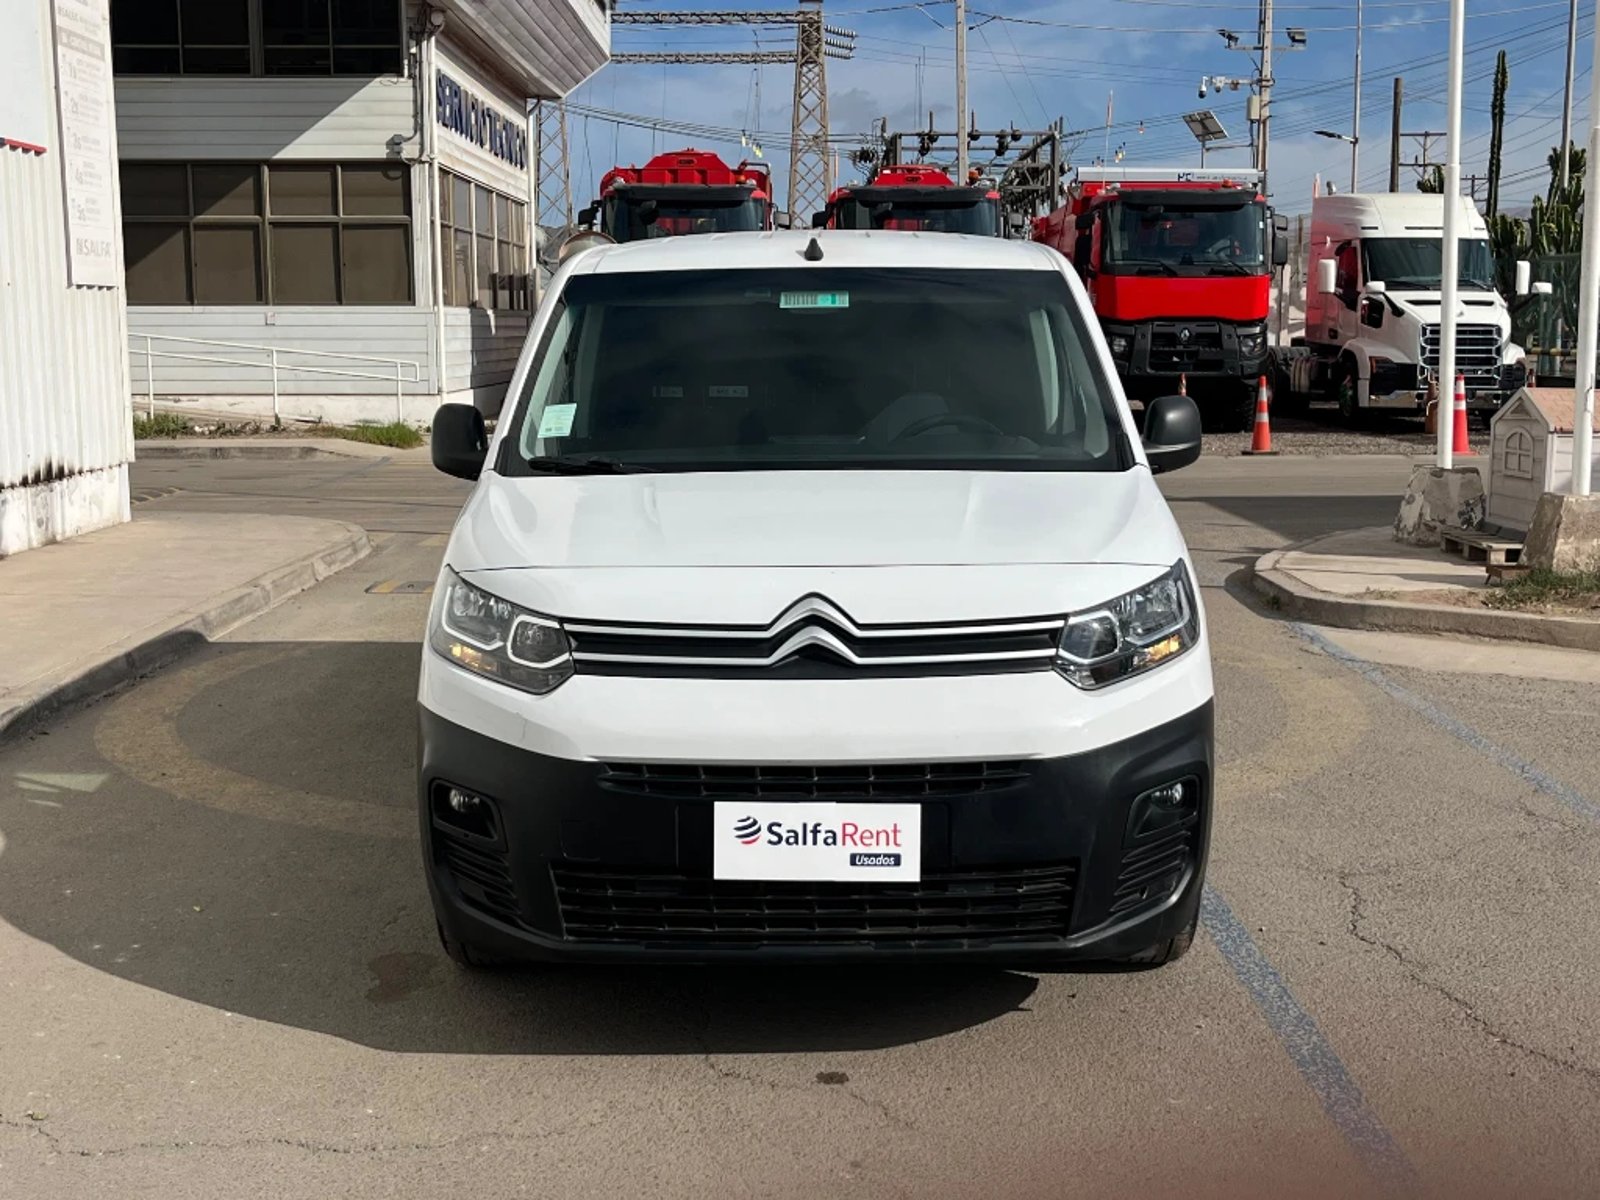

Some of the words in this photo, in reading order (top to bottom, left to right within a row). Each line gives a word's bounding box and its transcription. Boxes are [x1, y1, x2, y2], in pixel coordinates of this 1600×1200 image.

[436, 69, 486, 148] SERVICIO
[766, 821, 902, 847] SalfaRent
[855, 854, 896, 866] Usados
